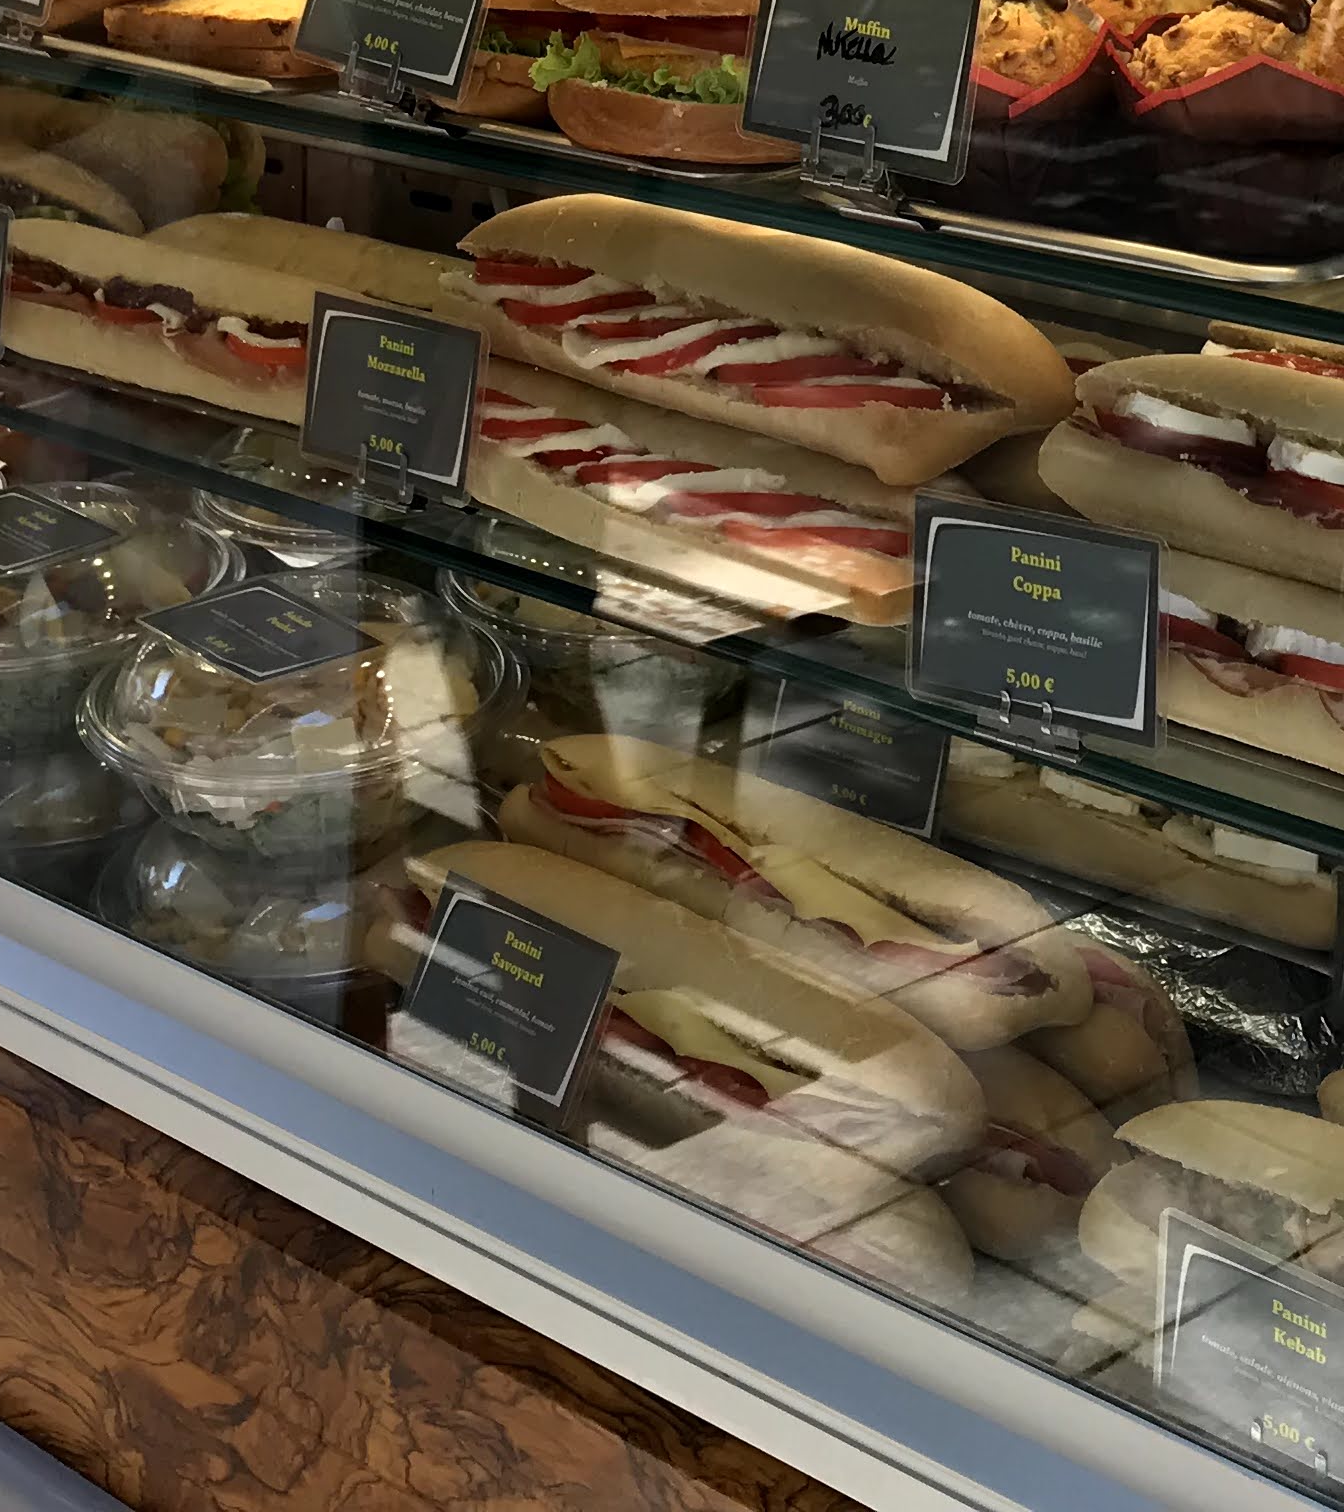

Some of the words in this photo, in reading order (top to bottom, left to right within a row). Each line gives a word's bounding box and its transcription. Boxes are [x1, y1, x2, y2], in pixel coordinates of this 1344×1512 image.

[363, 32, 389, 50] 4,00
[844, 16, 891, 40] Muffin
[379, 334, 415, 357] Panini
[367, 354, 426, 383] Mozzarella
[369, 434, 394, 453] 5,00
[1010, 545, 1062, 572] Panini
[1012, 575, 1063, 603] Coppa
[967, 609, 1002, 627] tomate,
[1002, 617, 1037, 636] chèvre,
[1037, 626, 1069, 642] coppa,
[1070, 631, 1104, 649] basilic
[1006, 668, 1041, 690] 5,00
[838, 716, 894, 745] fromages
[503, 928, 545, 961] Panini
[490, 950, 545, 989] Savoyard
[469, 1031, 496, 1055] 5,00
[1271, 1298, 1328, 1340] Panini
[1272, 1326, 1328, 1365] Kebab
[1262, 1413, 1301, 1444] 5,00
